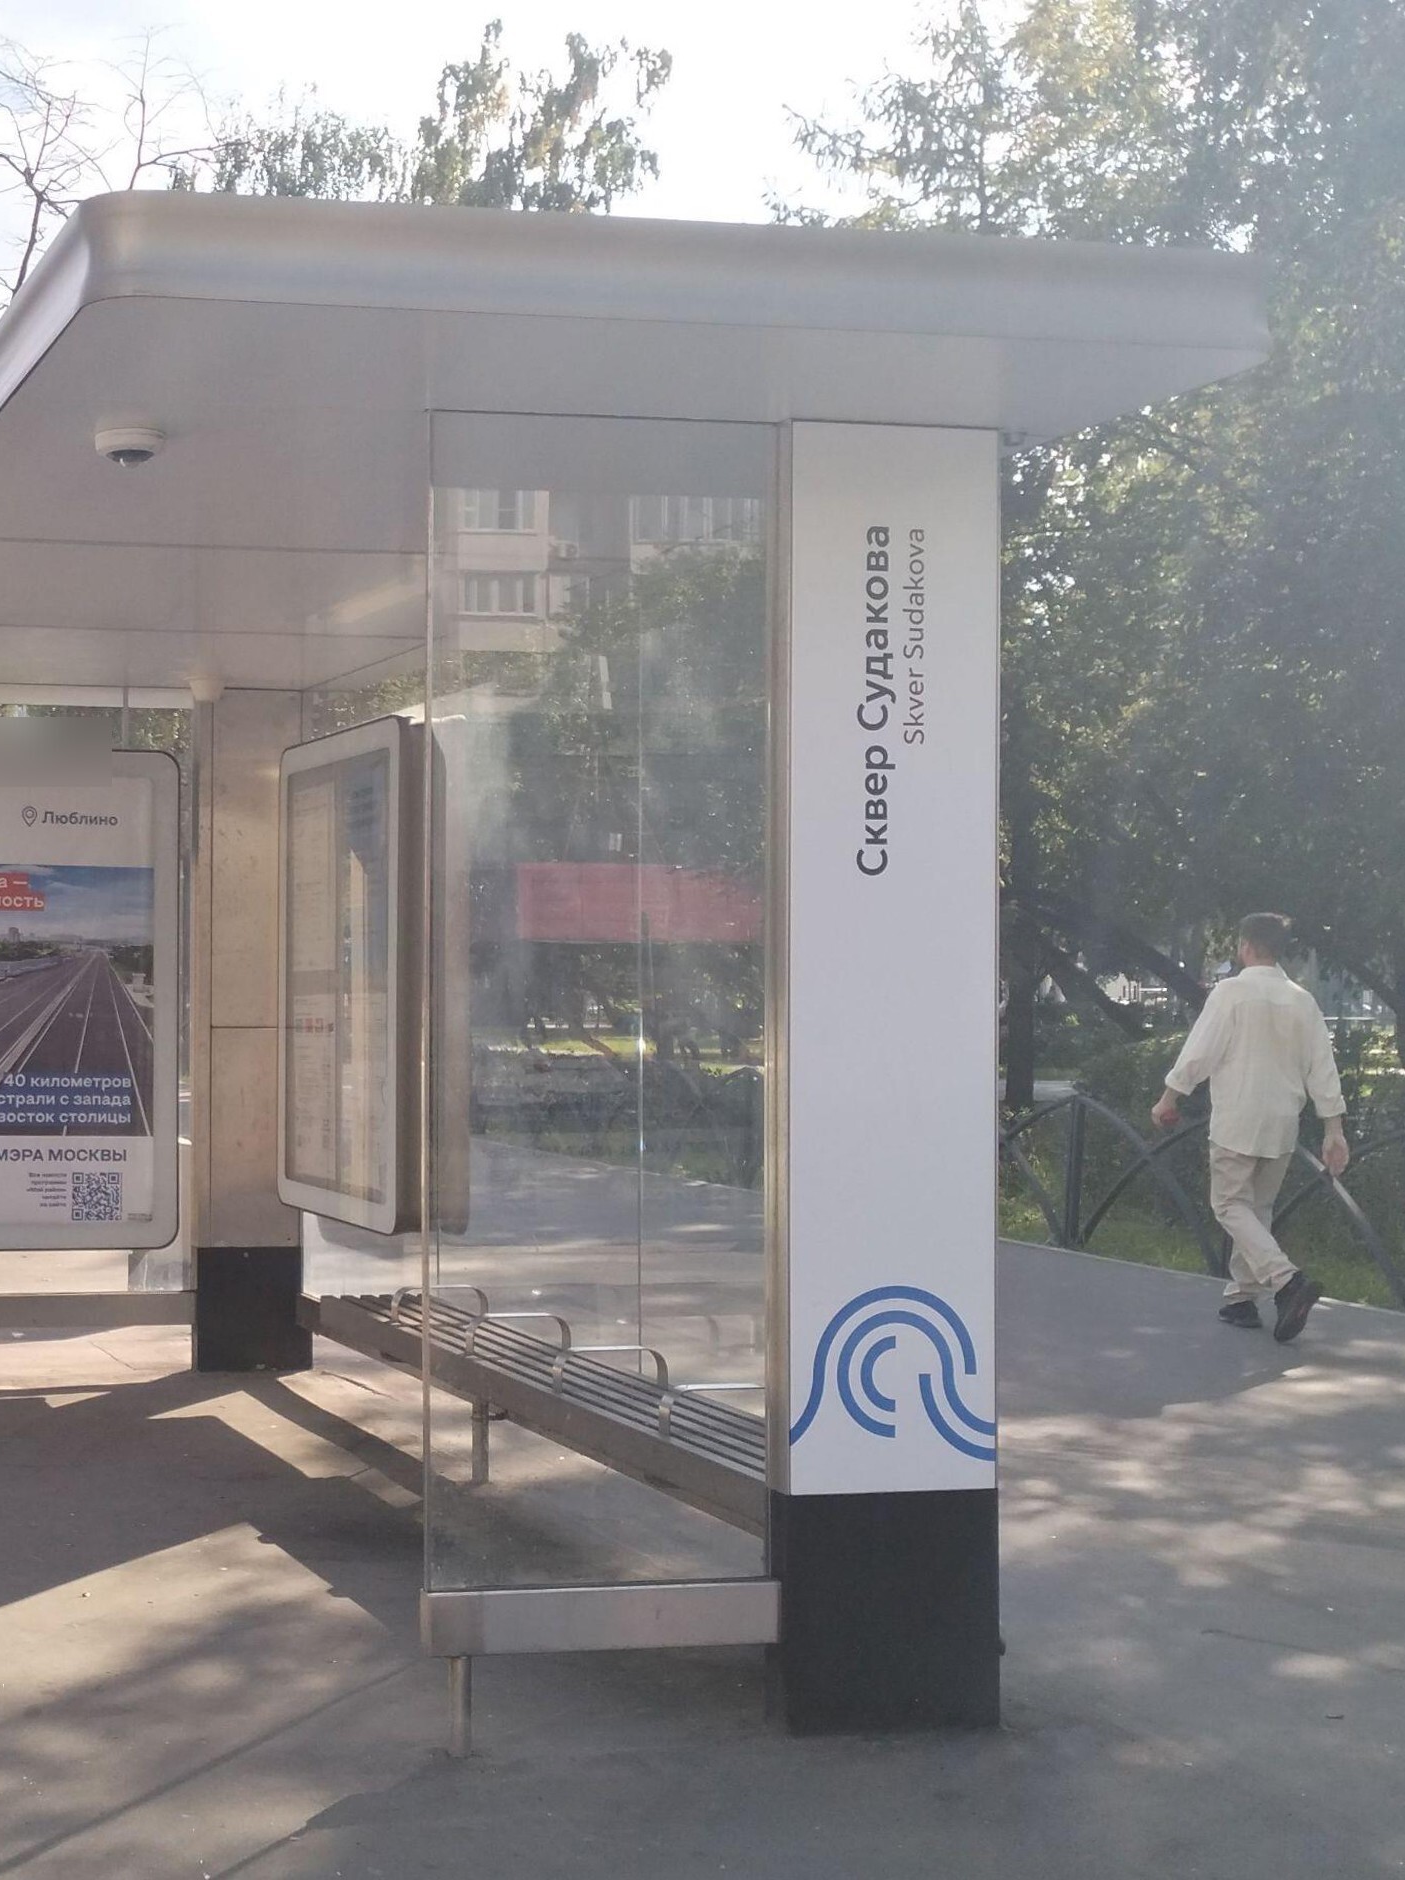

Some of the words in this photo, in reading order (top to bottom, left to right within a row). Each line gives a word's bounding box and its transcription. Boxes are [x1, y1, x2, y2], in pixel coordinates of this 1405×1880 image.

[902, 527, 925, 659] Sudakova
[856, 524, 896, 732] Судакова
[903, 668, 924, 745] Skver
[41, 811, 118, 826] Люблино
[856, 744, 896, 876] Сквер
[3, 1074, 26, 1088] 40
[30, 1077, 132, 1091] километров
[59, 1095, 70, 1105] с
[73, 1096, 132, 1107] запада
[58, 1112, 132, 1125] столицы
[48, 1149, 127, 1162] МОСКВЫ
